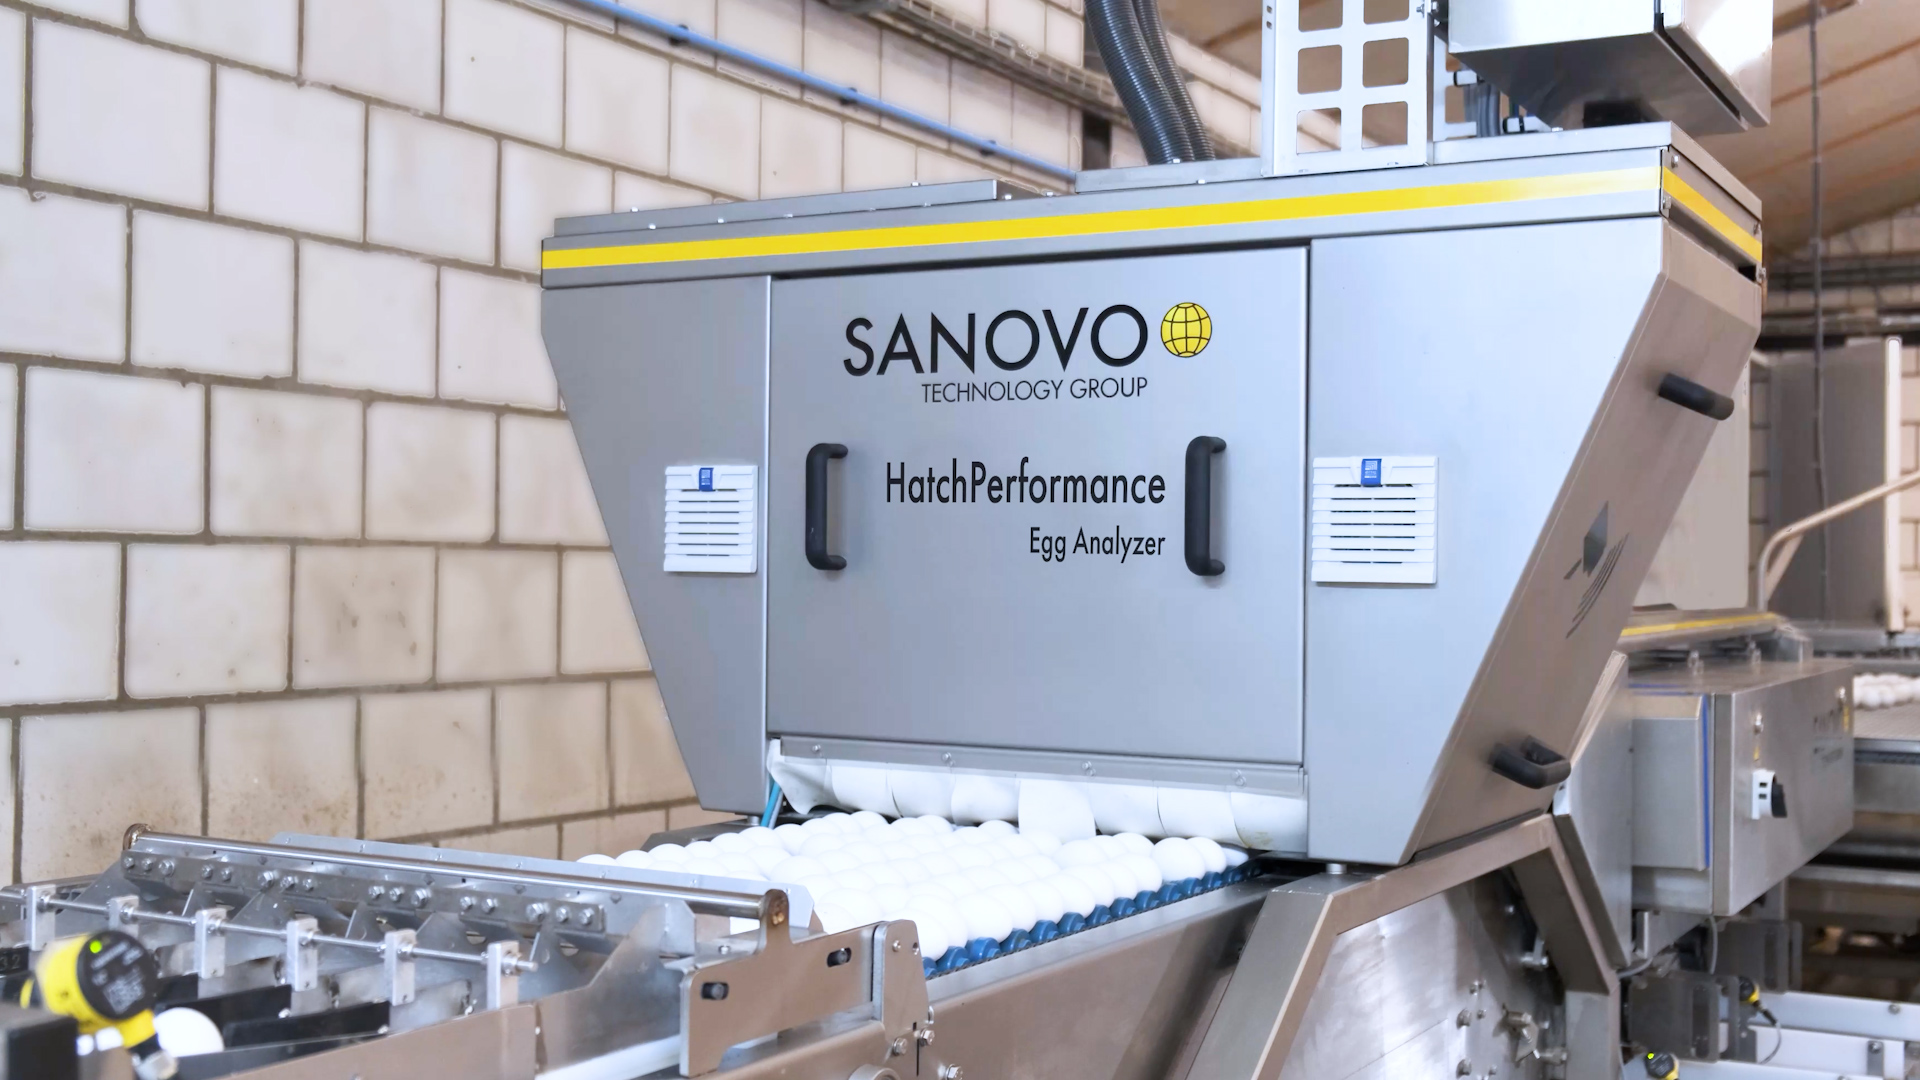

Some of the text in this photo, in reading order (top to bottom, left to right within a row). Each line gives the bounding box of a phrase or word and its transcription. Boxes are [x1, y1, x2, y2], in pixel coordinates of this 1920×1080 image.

[844, 304, 1148, 377] SANOVO
[921, 377, 1148, 403] TECHNOLOGY GROUP
[886, 456, 1166, 504] HatchPerformance
[1029, 525, 1166, 563] Egg Analyzer
